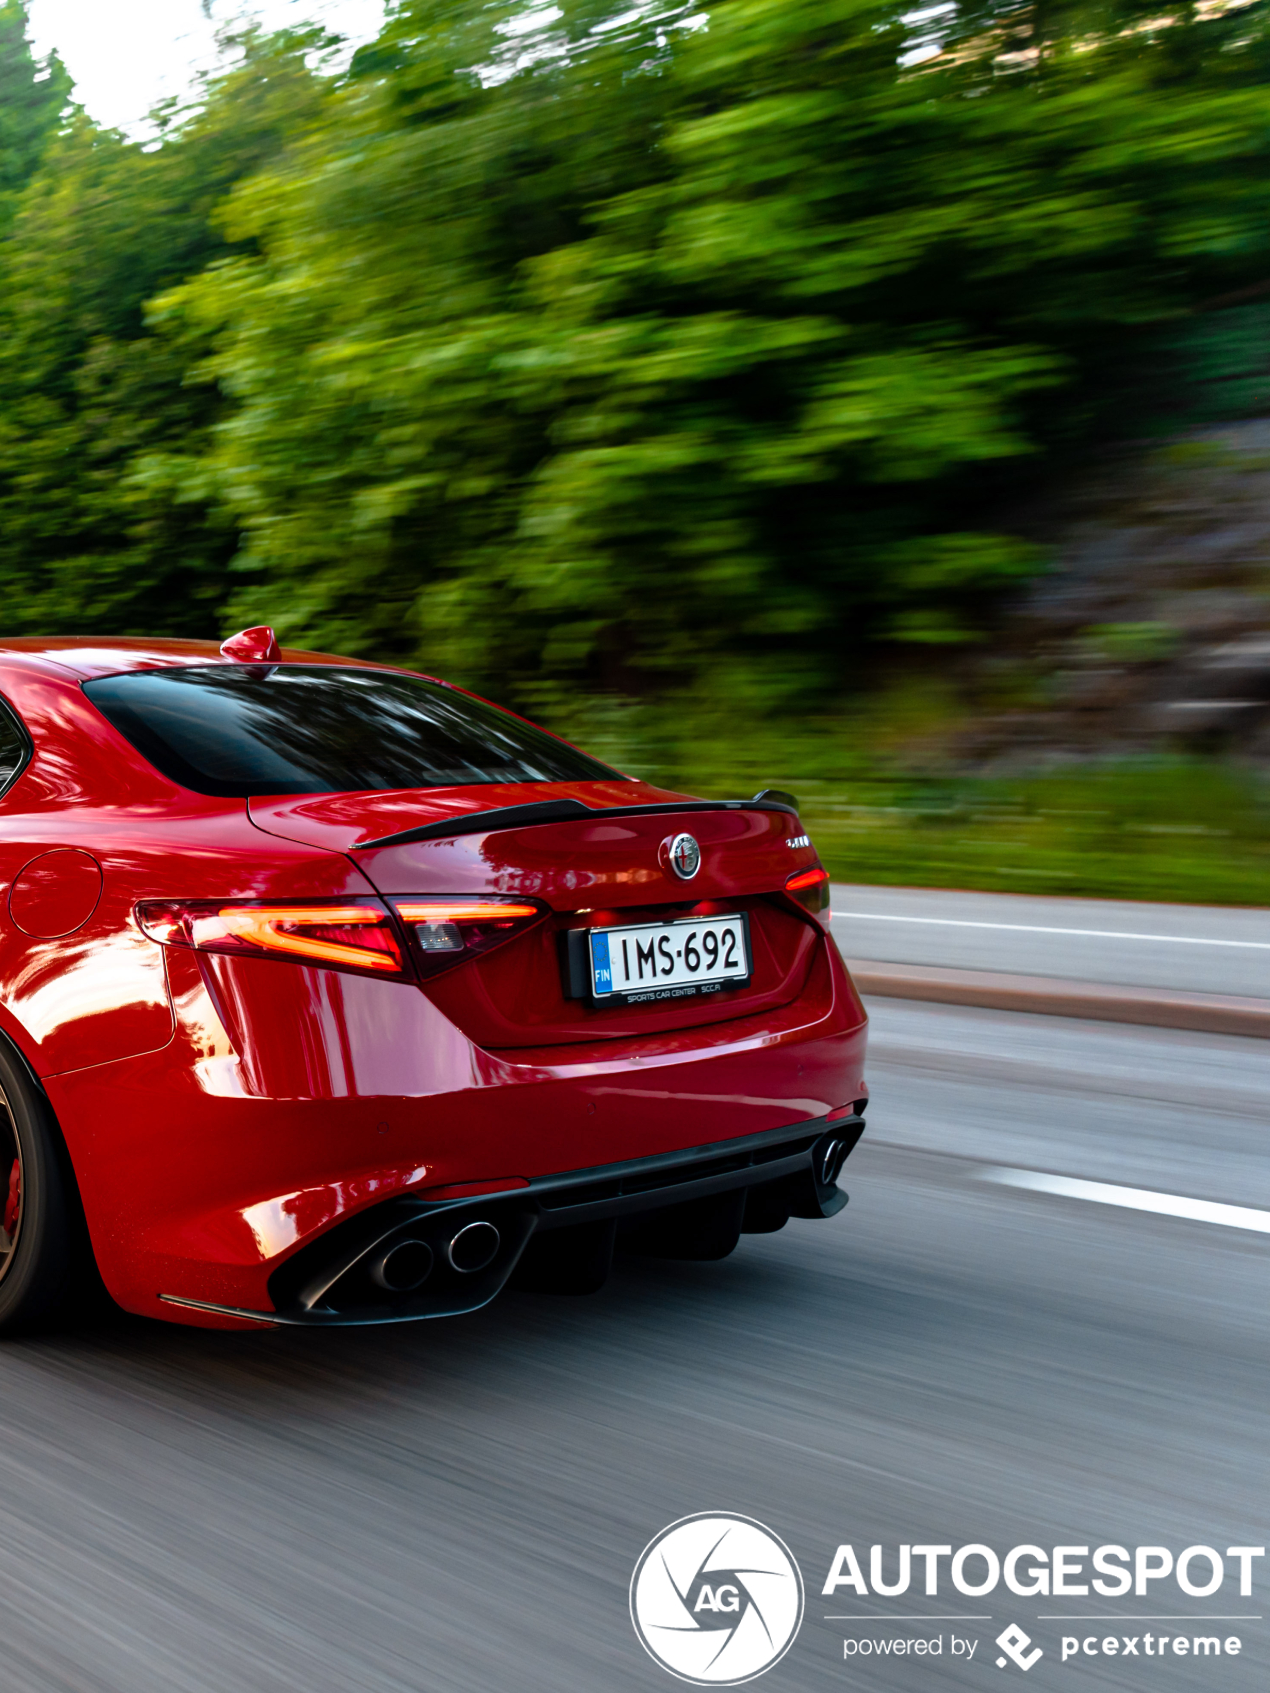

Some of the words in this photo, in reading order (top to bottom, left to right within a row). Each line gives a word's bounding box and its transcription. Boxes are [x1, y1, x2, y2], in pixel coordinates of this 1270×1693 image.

[595, 968, 610, 982] FIN
[627, 992, 655, 1003] SPORTS
[656, 990, 670, 999] CAR
[671, 987, 696, 997] CENTER
[701, 984, 721, 993] SCC.FI
